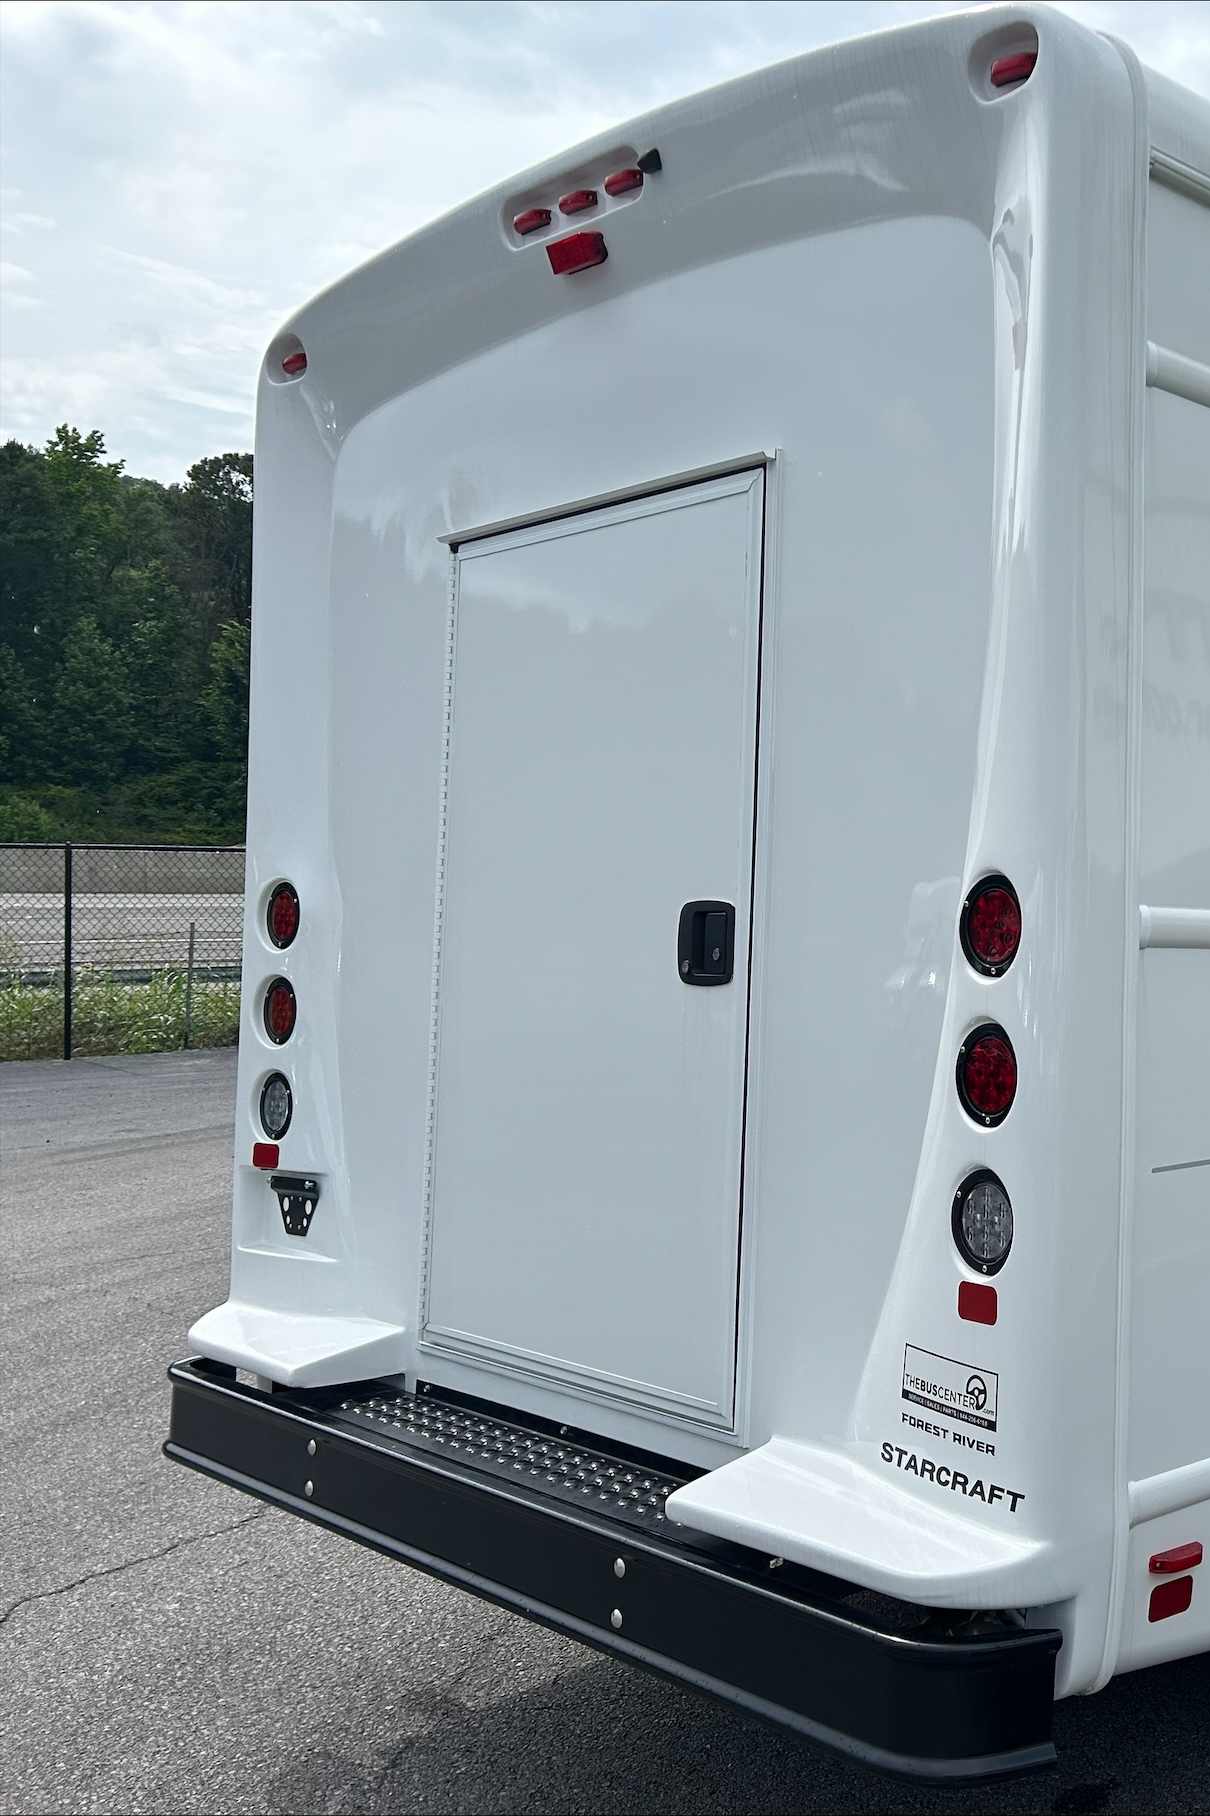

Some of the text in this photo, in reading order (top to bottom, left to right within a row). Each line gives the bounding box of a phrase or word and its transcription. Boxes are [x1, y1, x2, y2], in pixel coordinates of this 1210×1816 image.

[901, 1412, 996, 1457] FOREST RIVER
[880, 1442, 1026, 1513] STARCRAFT
